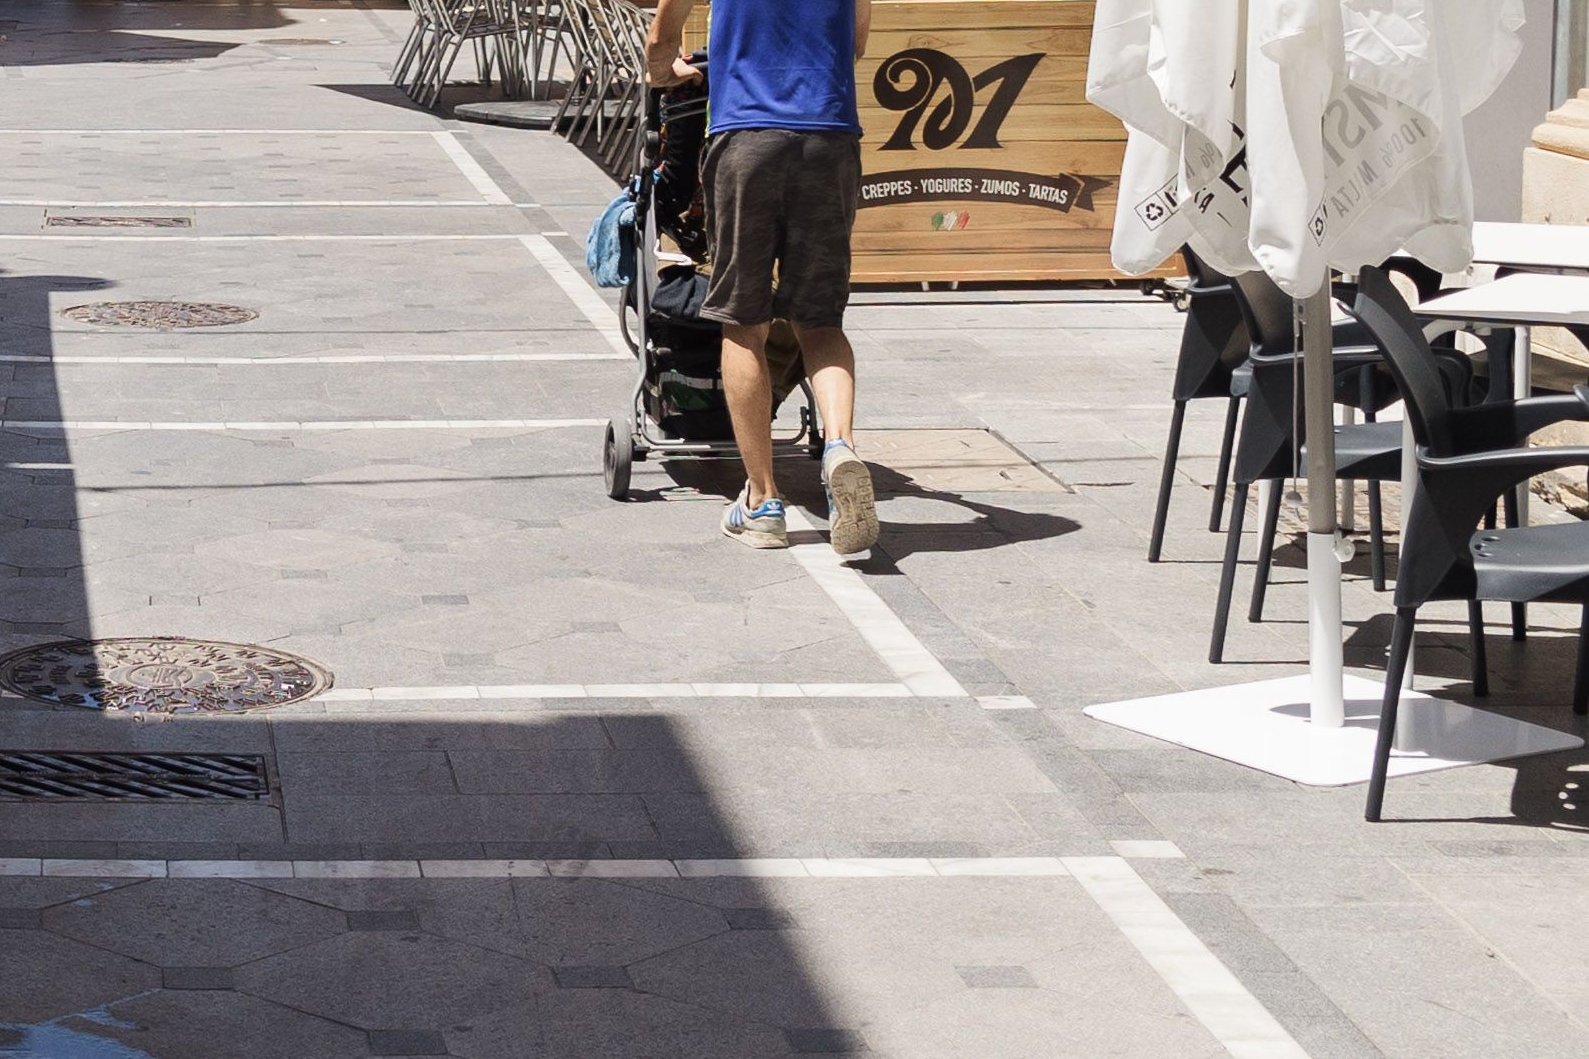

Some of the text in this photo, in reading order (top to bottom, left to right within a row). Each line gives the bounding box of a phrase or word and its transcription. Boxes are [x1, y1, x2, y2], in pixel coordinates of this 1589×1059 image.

[861, 178, 1069, 205] CREPPES YOGURES ZUMOS TARTAS
